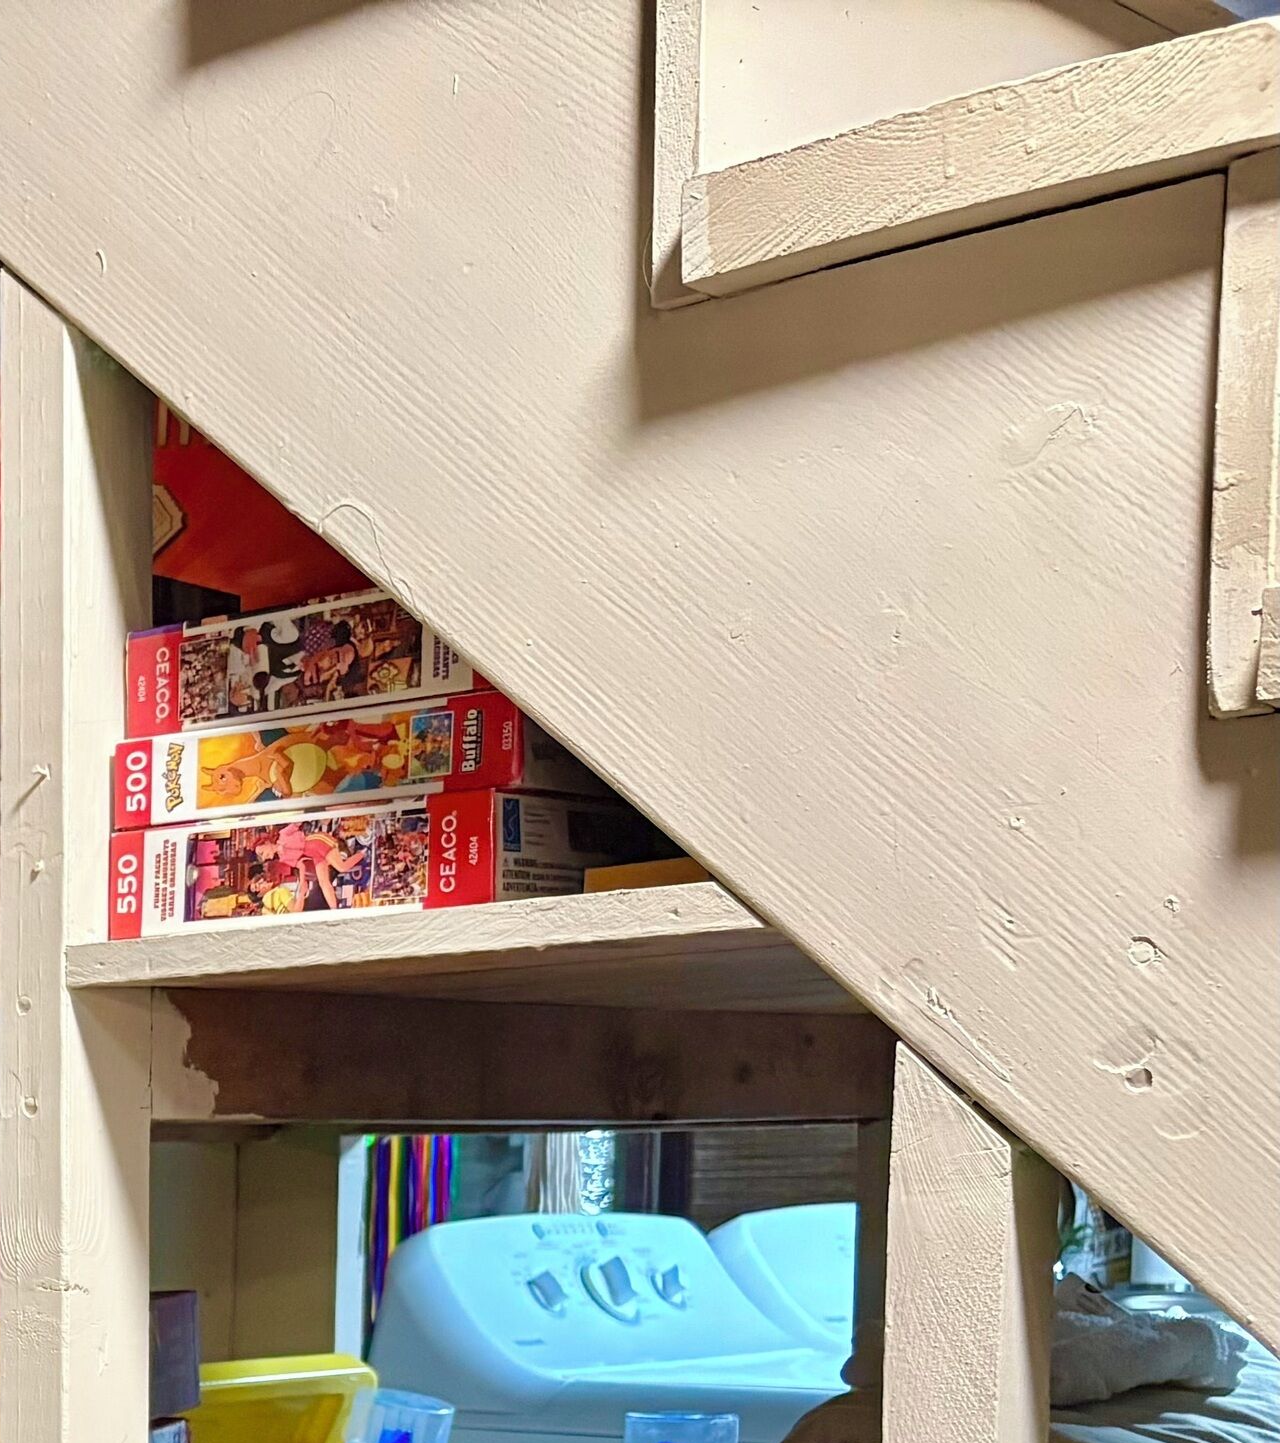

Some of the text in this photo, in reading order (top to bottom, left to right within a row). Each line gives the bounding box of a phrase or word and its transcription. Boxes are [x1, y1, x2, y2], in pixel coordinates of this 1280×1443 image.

[461, 709, 479, 772] Buffalo
[126, 750, 147, 813] 500
[469, 836, 478, 867] 42404
[117, 854, 136, 914] 550
